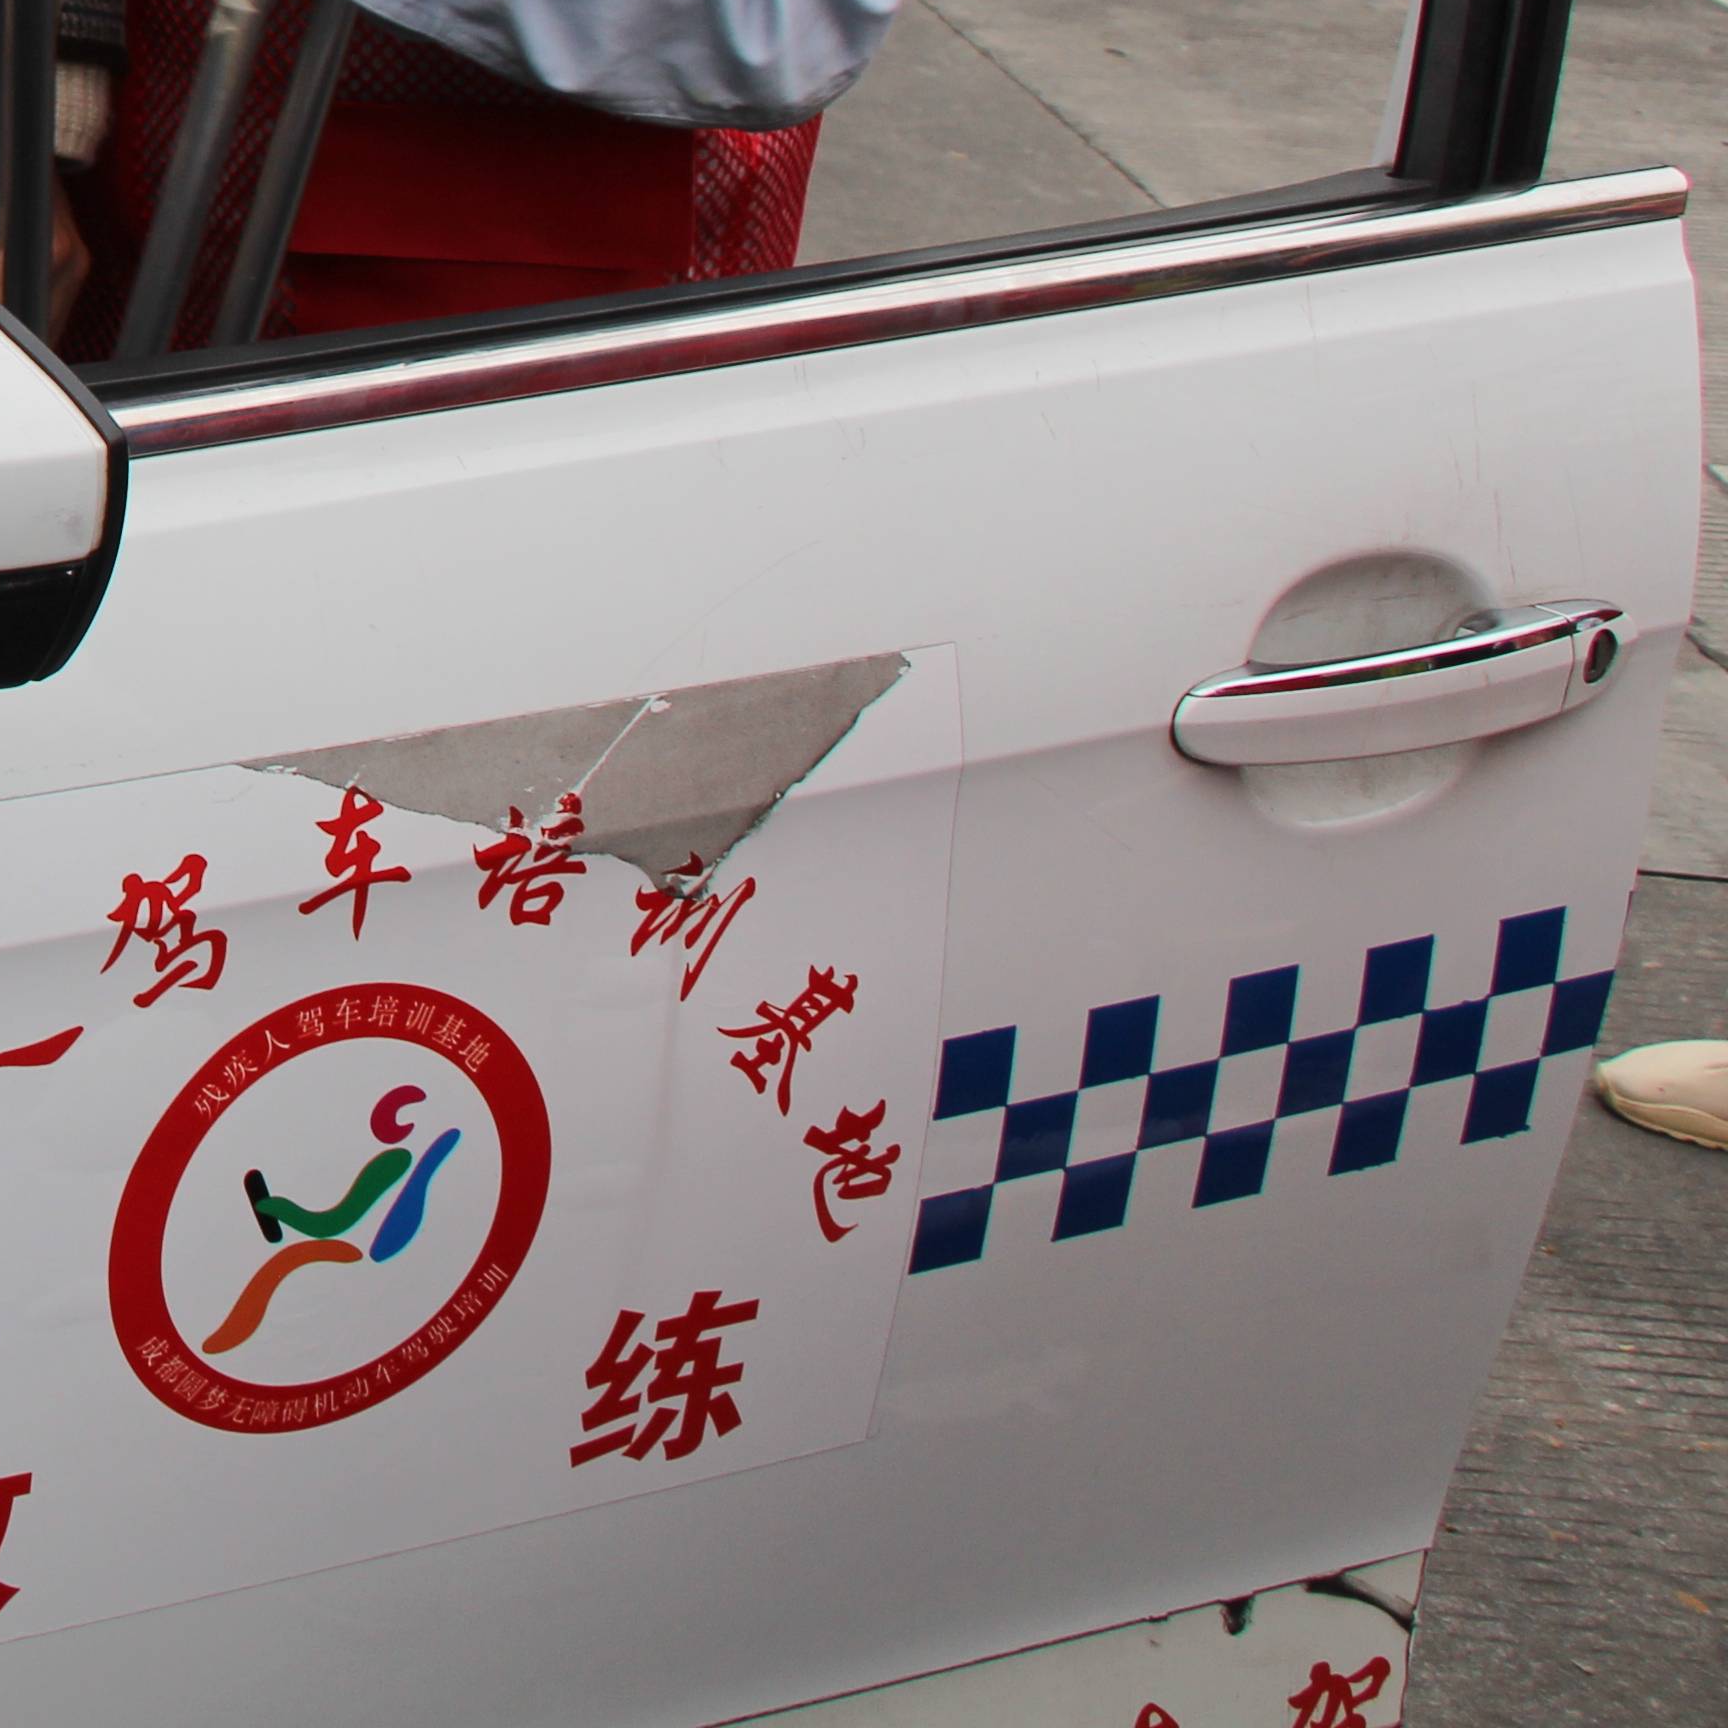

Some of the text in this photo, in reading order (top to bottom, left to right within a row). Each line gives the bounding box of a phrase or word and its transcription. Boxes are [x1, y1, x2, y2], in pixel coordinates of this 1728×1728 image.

[193, 995, 492, 1120] 残疾人驾车培训基地
